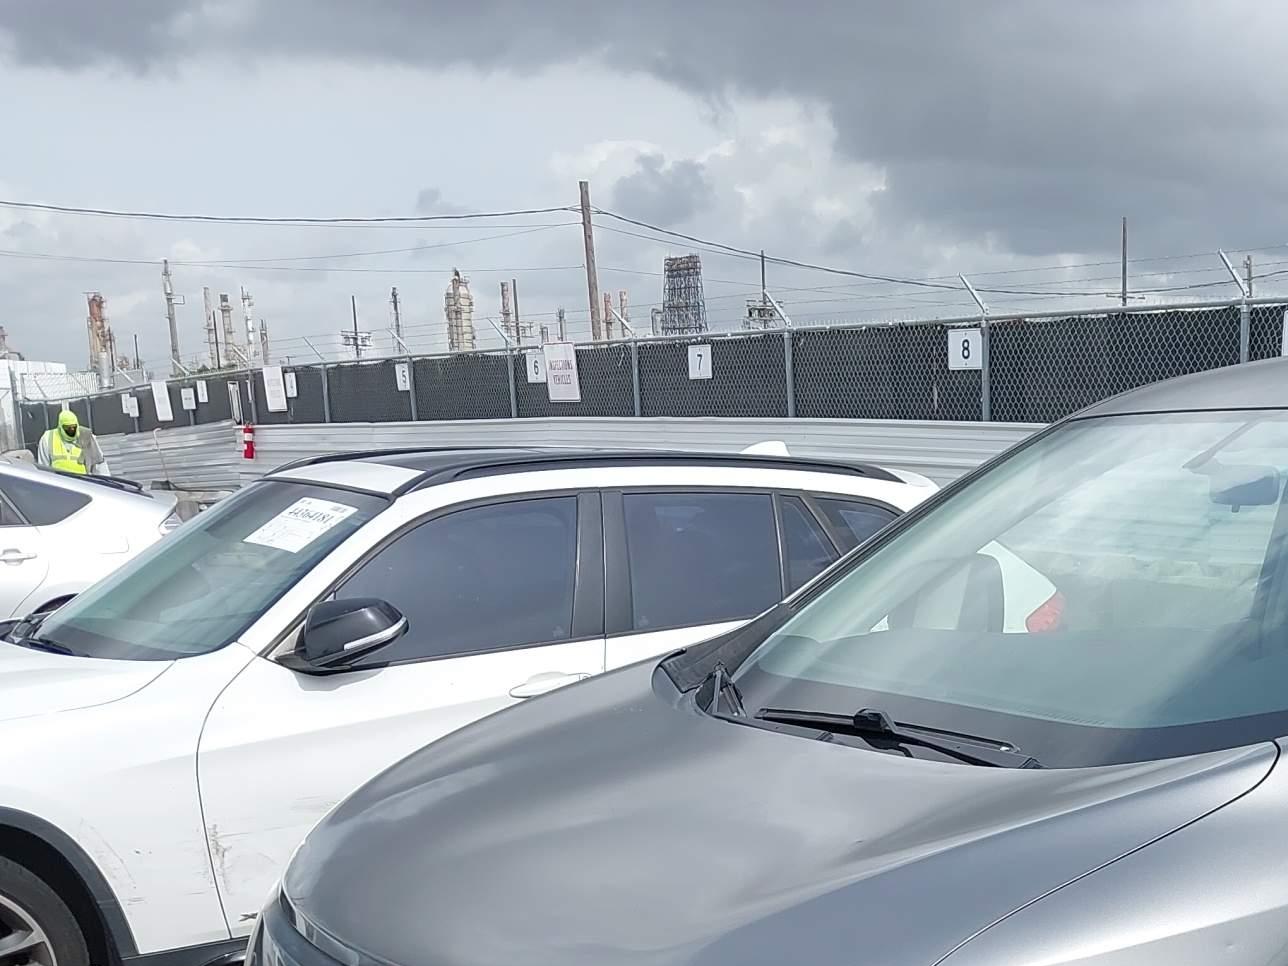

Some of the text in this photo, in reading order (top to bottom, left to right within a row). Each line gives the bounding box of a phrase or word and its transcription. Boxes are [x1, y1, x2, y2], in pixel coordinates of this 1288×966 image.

[961, 339, 970, 360] 8
[533, 359, 540, 375] 6
[696, 353, 703, 371] 7
[401, 370, 407, 384] 5
